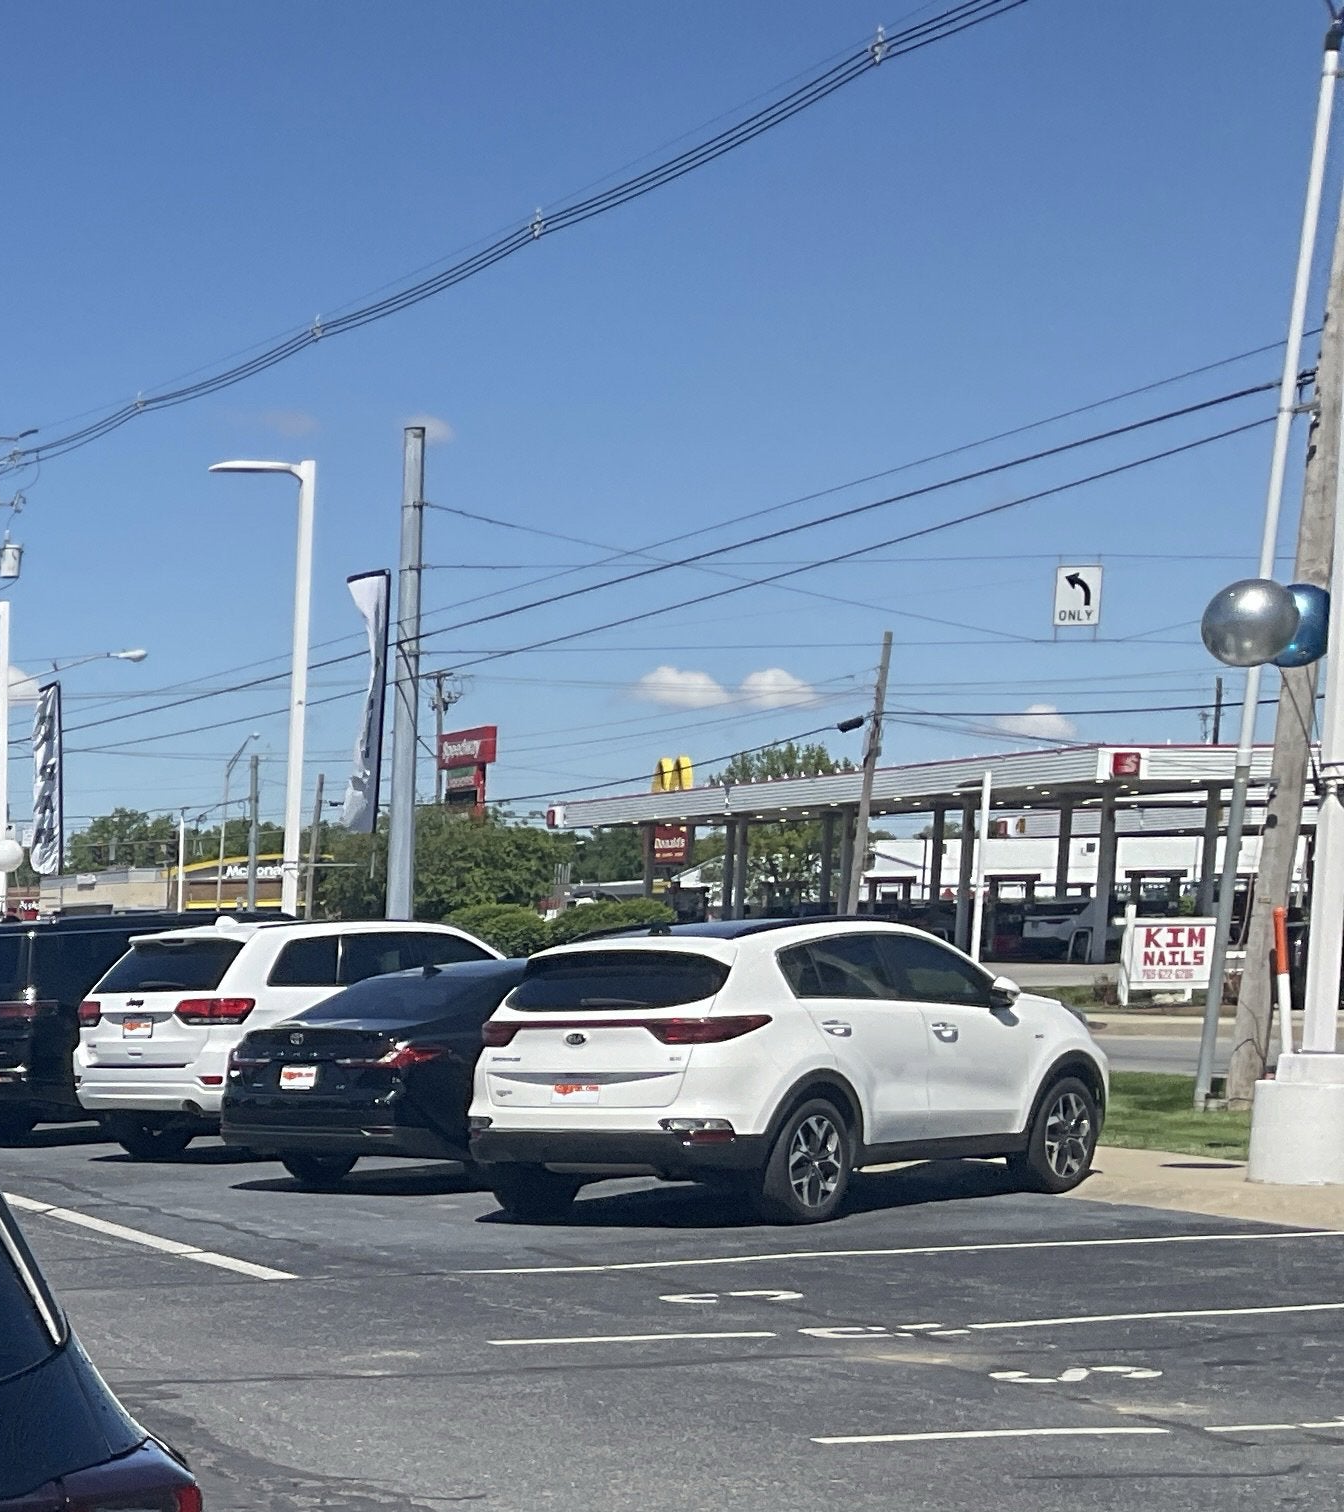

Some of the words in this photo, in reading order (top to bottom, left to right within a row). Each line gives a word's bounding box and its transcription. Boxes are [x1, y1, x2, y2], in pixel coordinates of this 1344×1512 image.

[1058, 609, 1094, 621] ONLY
[1144, 927, 1206, 948] KIM
[1143, 951, 1204, 966] NAILS
